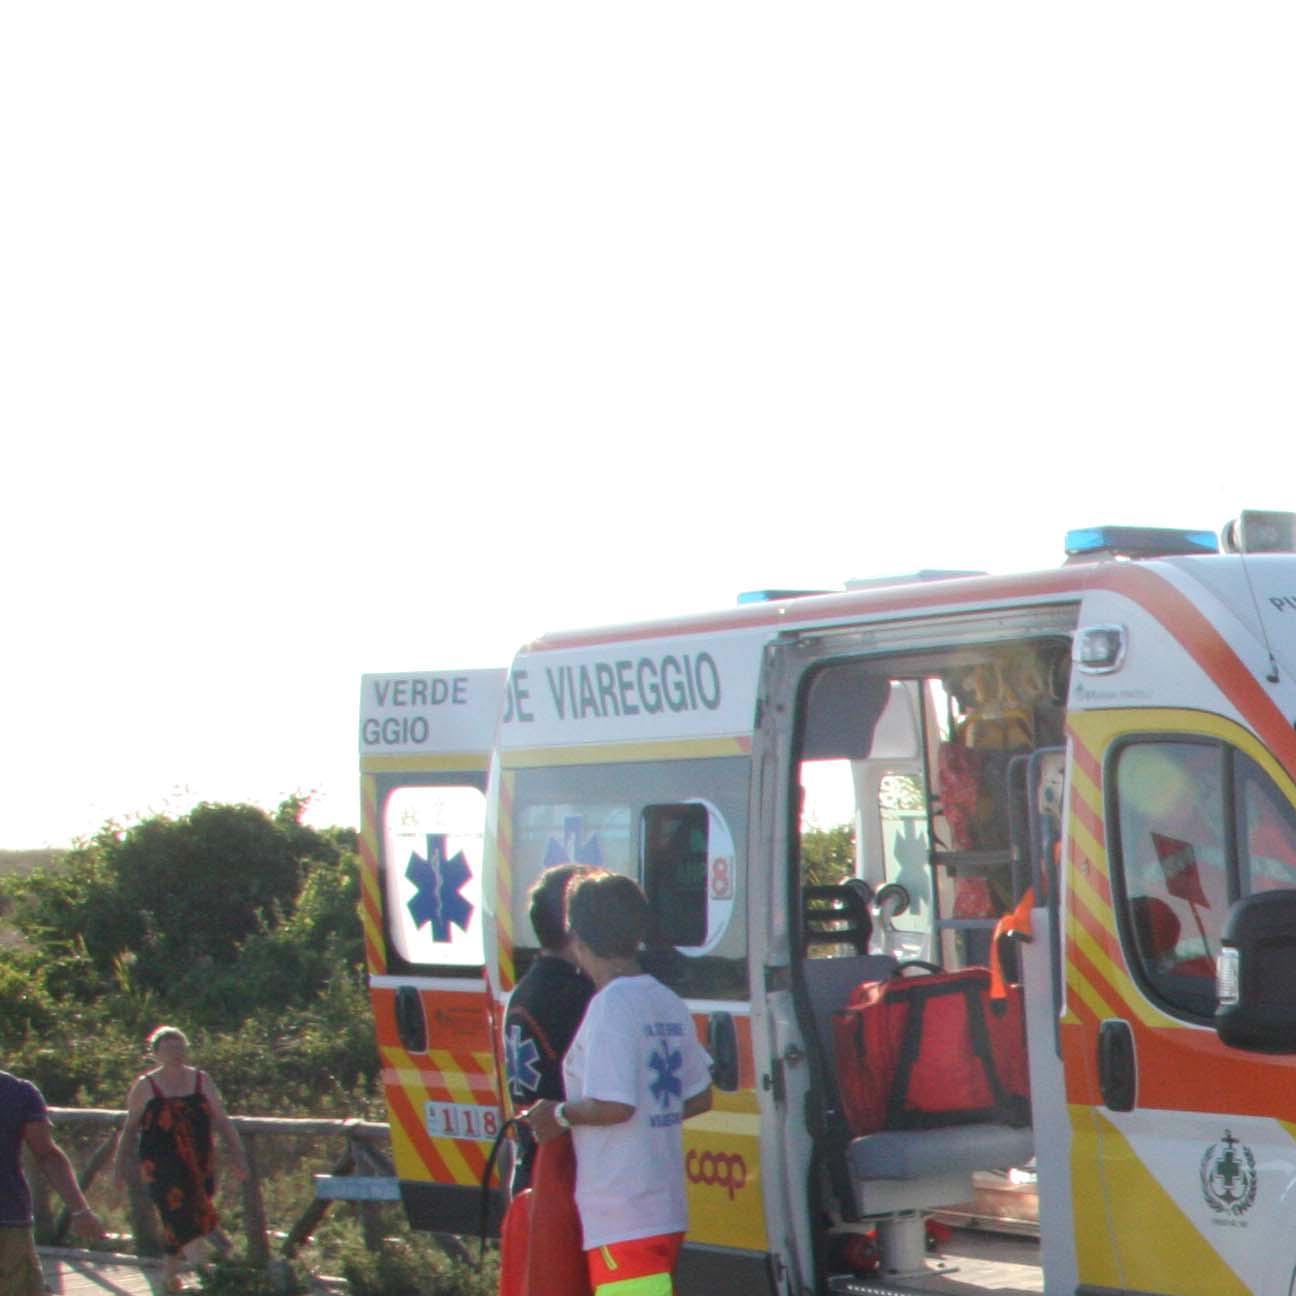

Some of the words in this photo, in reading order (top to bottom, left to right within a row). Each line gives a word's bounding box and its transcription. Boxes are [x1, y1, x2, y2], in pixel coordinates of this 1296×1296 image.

[373, 677, 470, 708] VERDE
[547, 651, 721, 721] VIAREGGIO
[362, 715, 430, 746] GGIO
[442, 1107, 497, 1136] 118
[686, 1148, 747, 1202] coop
